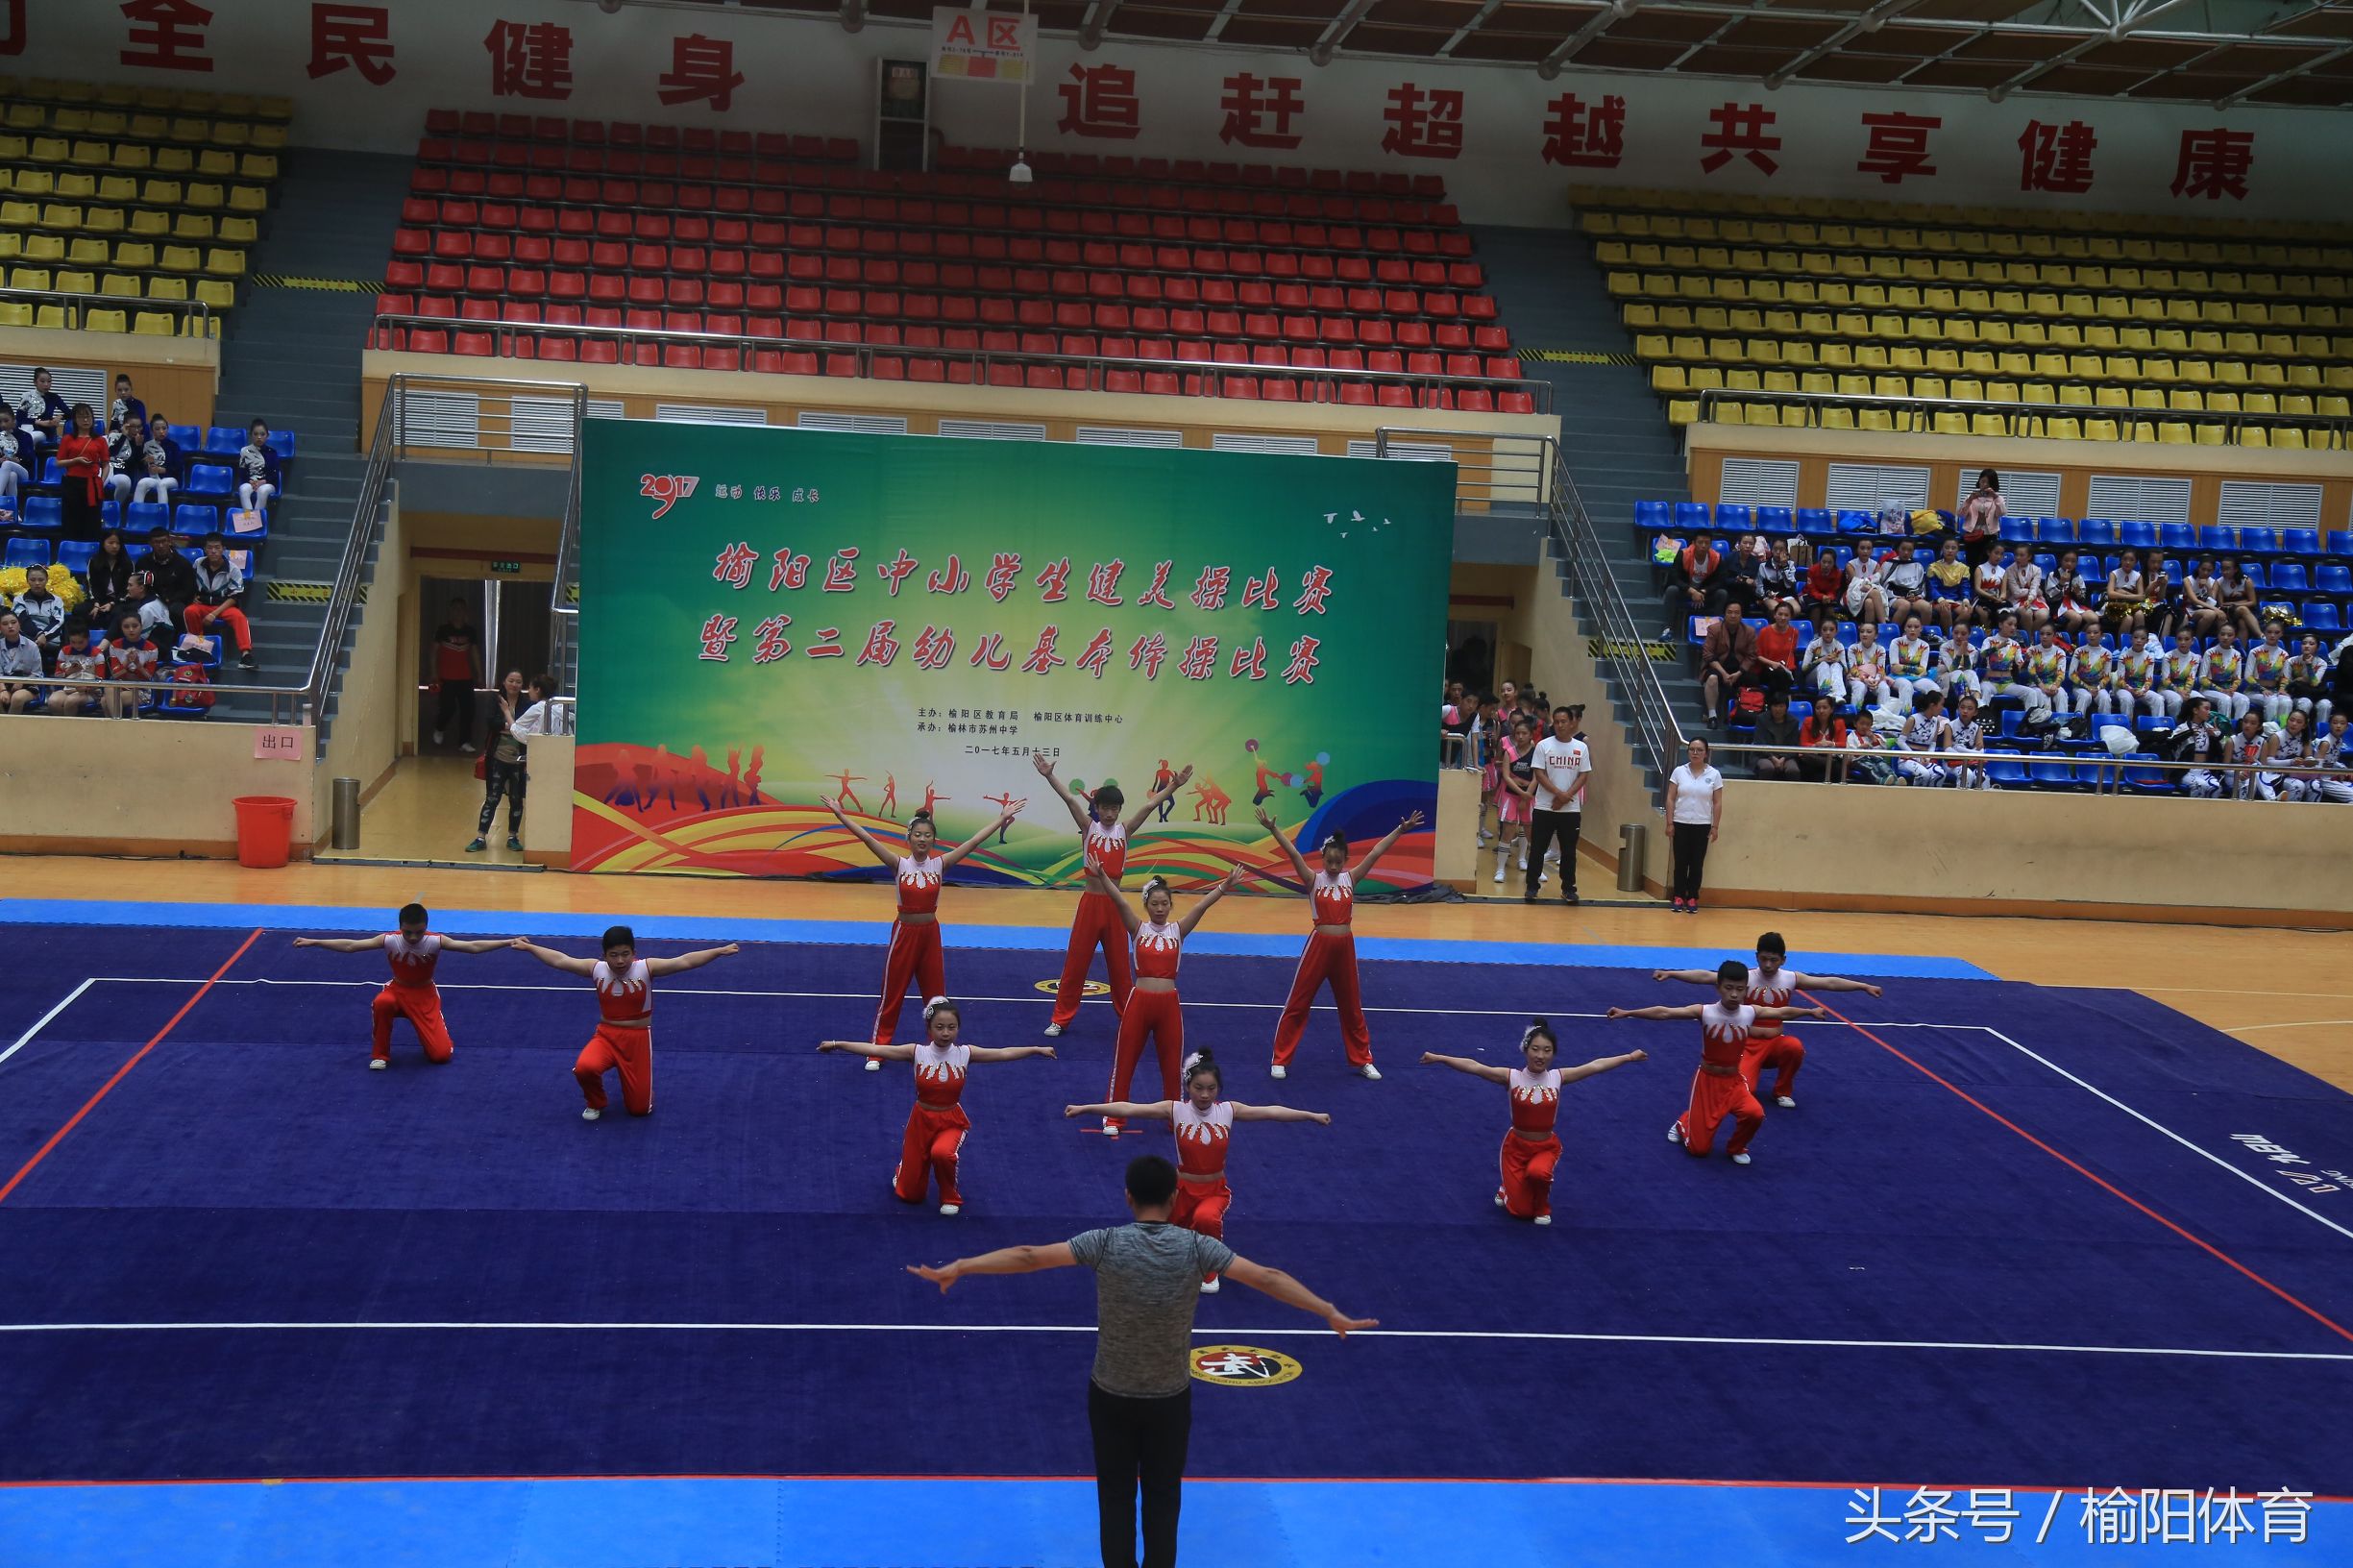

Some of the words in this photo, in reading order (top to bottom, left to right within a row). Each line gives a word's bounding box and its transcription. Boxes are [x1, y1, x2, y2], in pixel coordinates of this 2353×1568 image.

[946, 14, 1020, 51] A区
[753, 486, 781, 501] 快乐
[792, 488, 820, 502] 成长
[712, 541, 1336, 615] 榆阳区中小学生健美操比赛
[699, 613, 1322, 685] 暨第二届幼儿基本体操比赛
[1034, 711, 1123, 723] 榆阳区体育训练中心
[262, 734, 294, 749] 出口
[1550, 756, 1581, 767] CHINA
